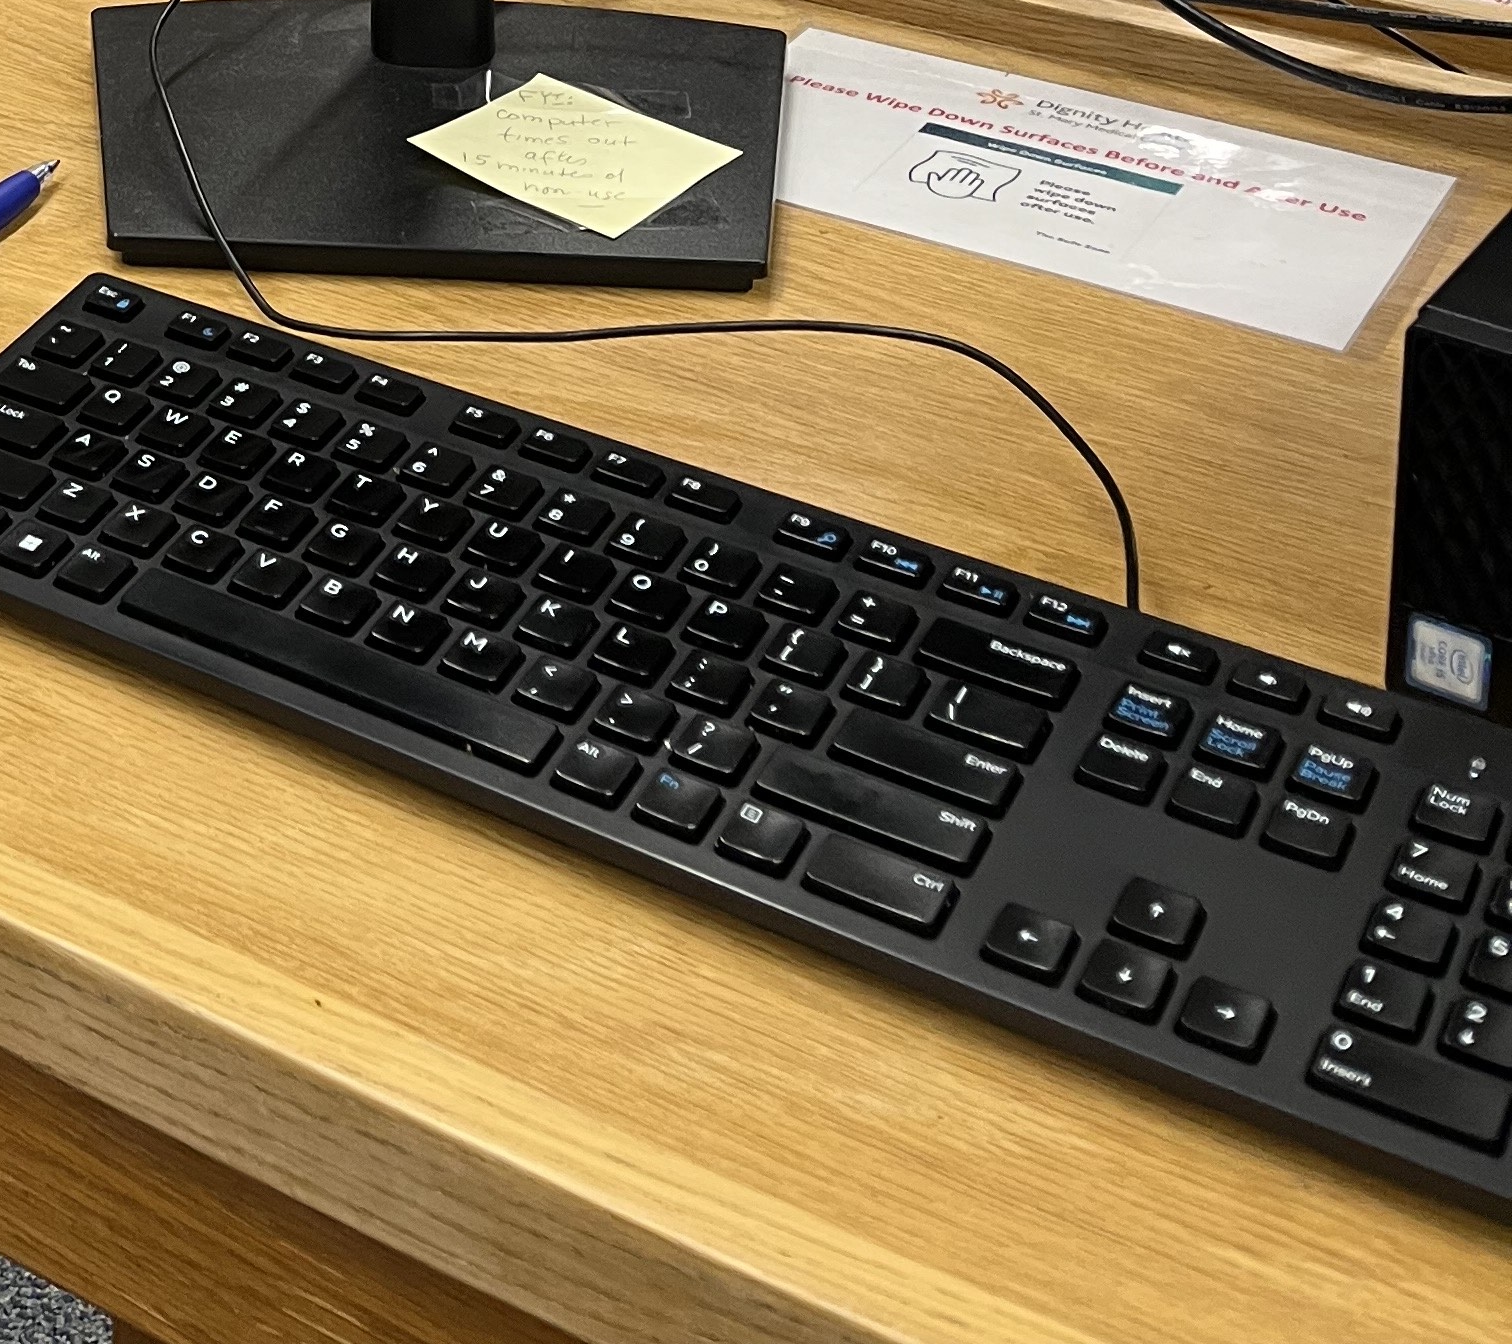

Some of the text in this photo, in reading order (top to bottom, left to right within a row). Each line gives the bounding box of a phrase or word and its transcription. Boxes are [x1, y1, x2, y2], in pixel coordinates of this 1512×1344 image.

[1037, 99, 1119, 126] Dignity
[498, 127, 638, 147] times out
[788, 73, 1368, 223] Please Wipe Down Surfaces Before and Aer Use
[462, 152, 625, 183] 15 minutes of
[523, 182, 626, 201] non use
[1034, 188, 1117, 212] wipe down
[1020, 202, 1060, 214] after
[1027, 195, 1096, 216] surfaces
[18, 358, 37, 372] Tab
[0, 403, 25, 420] Lock
[165, 410, 188, 426] W
[82, 548, 101, 562] Alt
[1040, 595, 1069, 611] F12
[462, 632, 489, 652] M
[990, 639, 1068, 674] Backspace
[1127, 685, 1172, 710] Insert
[1216, 715, 1264, 740] Home
[1100, 736, 1149, 762] Delete
[1308, 744, 1355, 770] PgUp
[964, 754, 1009, 776] Enter
[1190, 768, 1223, 789] End
[1429, 796, 1467, 816] Lock
[1431, 785, 1471, 808] Num
[938, 810, 977, 833] Shift
[1284, 799, 1331, 826] PgDn
[913, 873, 945, 893] Ctrl
